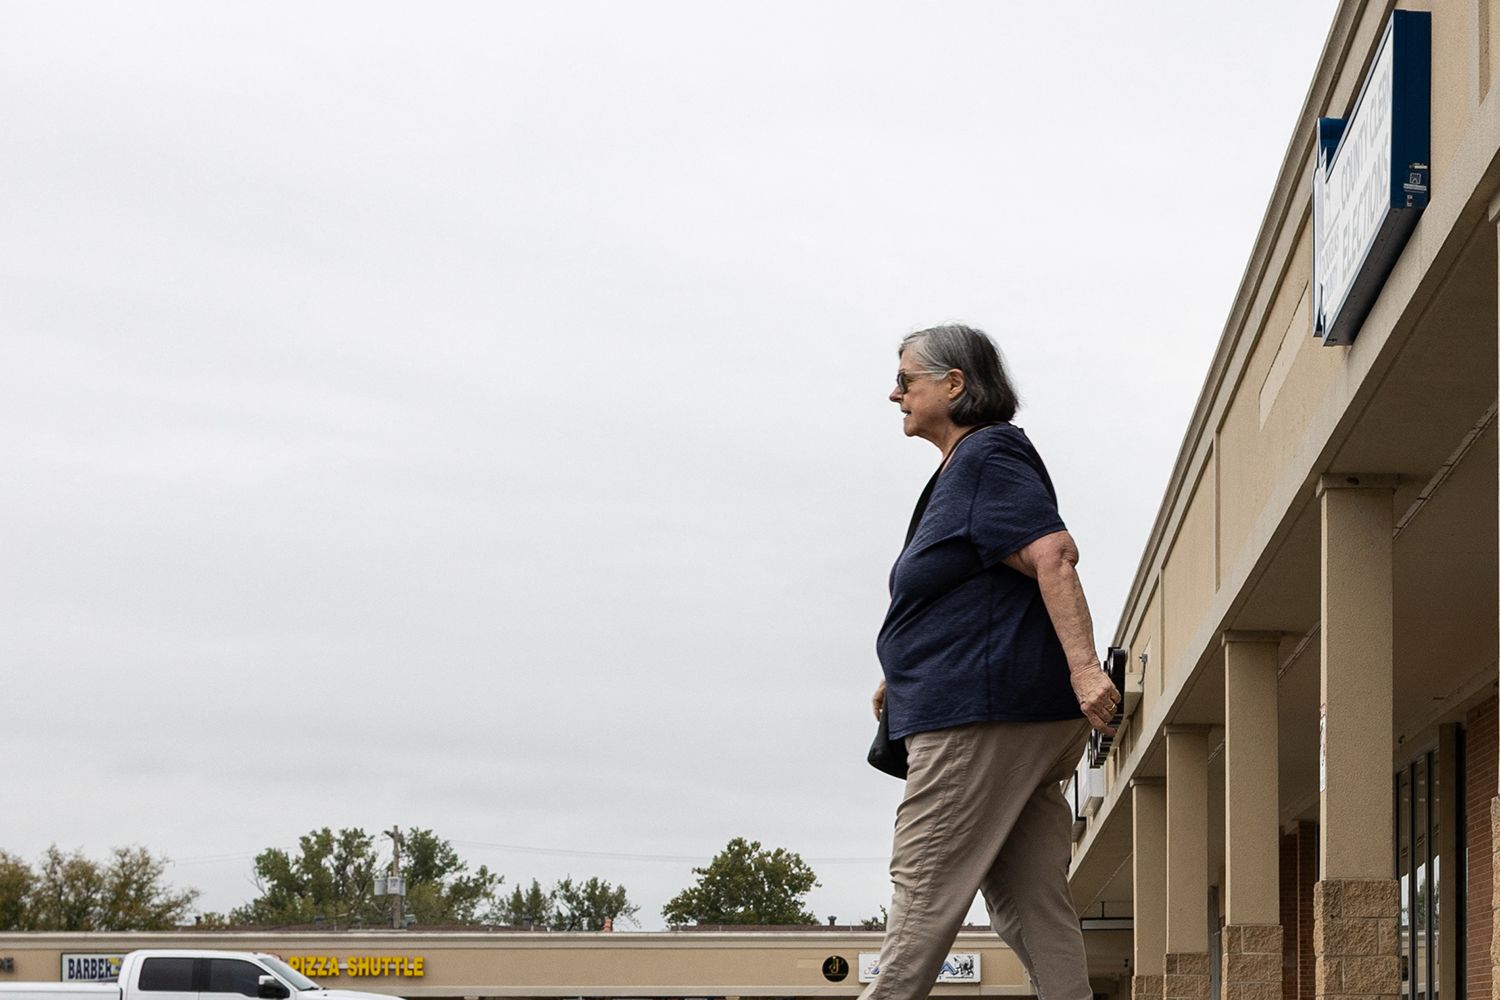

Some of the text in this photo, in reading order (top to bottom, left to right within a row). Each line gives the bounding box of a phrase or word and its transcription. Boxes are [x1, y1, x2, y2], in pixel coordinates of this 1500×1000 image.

[1343, 135, 1390, 277] ELECTIONS
[68, 958, 112, 979] BARBER
[289, 956, 424, 976] PIZZA SHUTTLE
